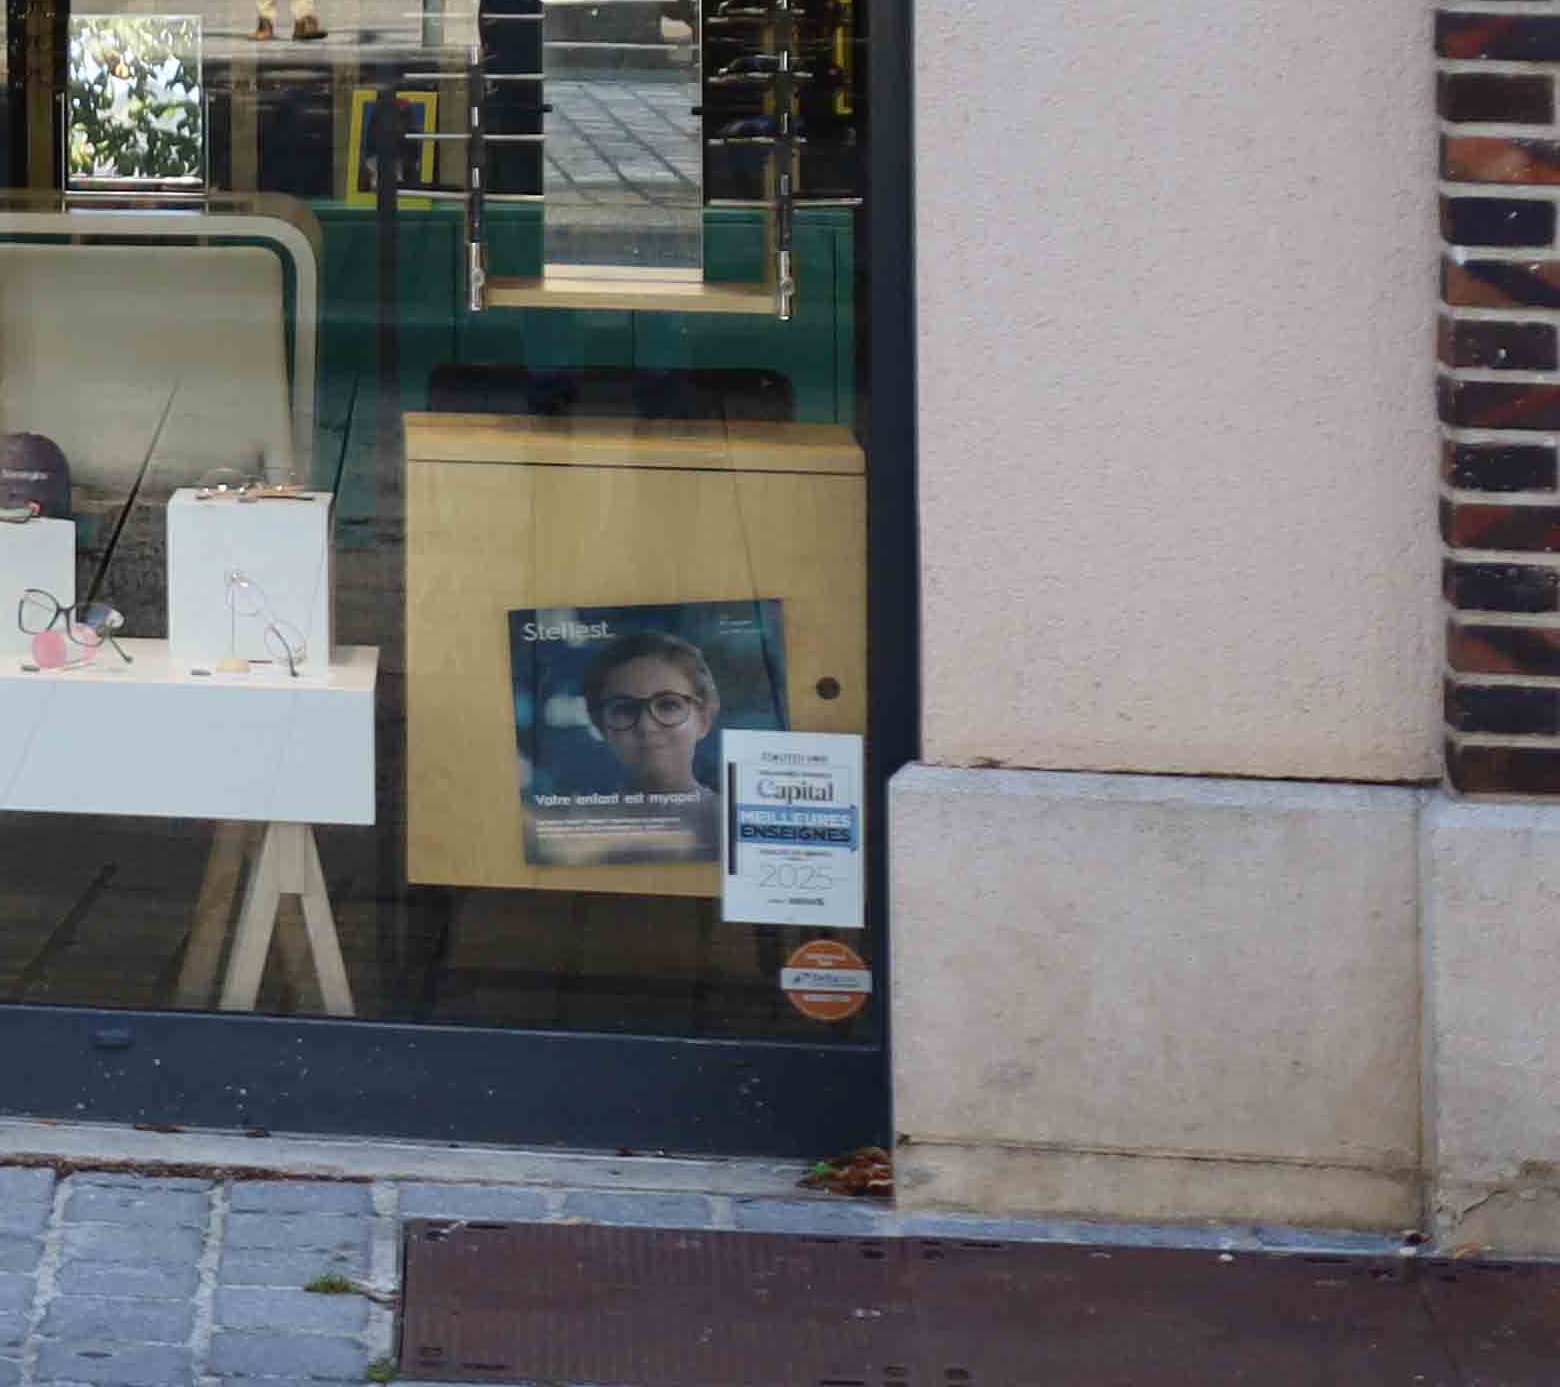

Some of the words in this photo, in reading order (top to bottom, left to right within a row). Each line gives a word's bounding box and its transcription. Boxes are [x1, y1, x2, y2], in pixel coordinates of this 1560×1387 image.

[534, 793, 572, 807] Votre
[623, 792, 644, 805] est
[756, 778, 835, 804] Capital
[739, 824, 852, 843] ENSEIGNES
[758, 862, 834, 891] 2025
